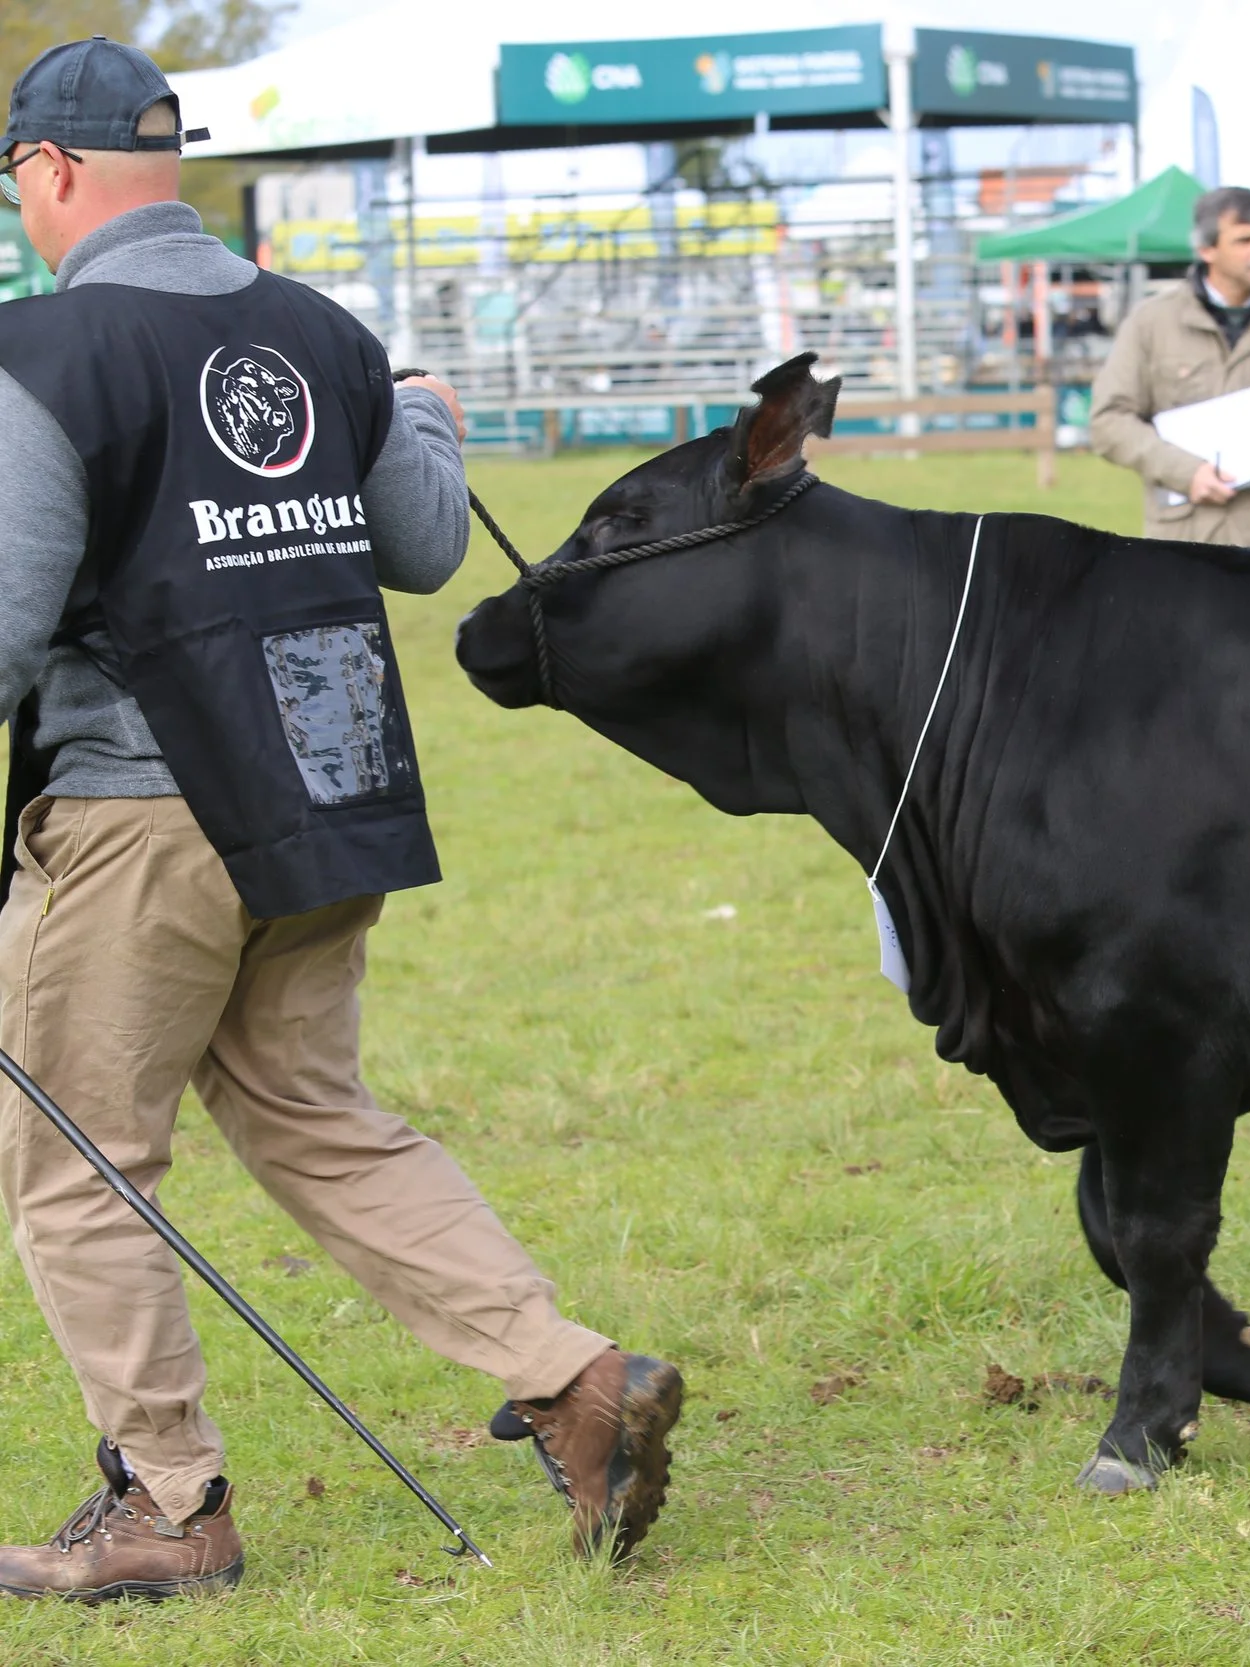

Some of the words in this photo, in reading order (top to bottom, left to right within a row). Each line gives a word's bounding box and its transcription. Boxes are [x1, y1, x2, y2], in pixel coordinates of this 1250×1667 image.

[188, 493, 367, 545] Brangus
[205, 550, 265, 572] ASSOCIAÇÃO
[267, 541, 326, 563] BRASILEIRA
[325, 542, 337, 554] DE
[335, 539, 372, 555] BRANGU
